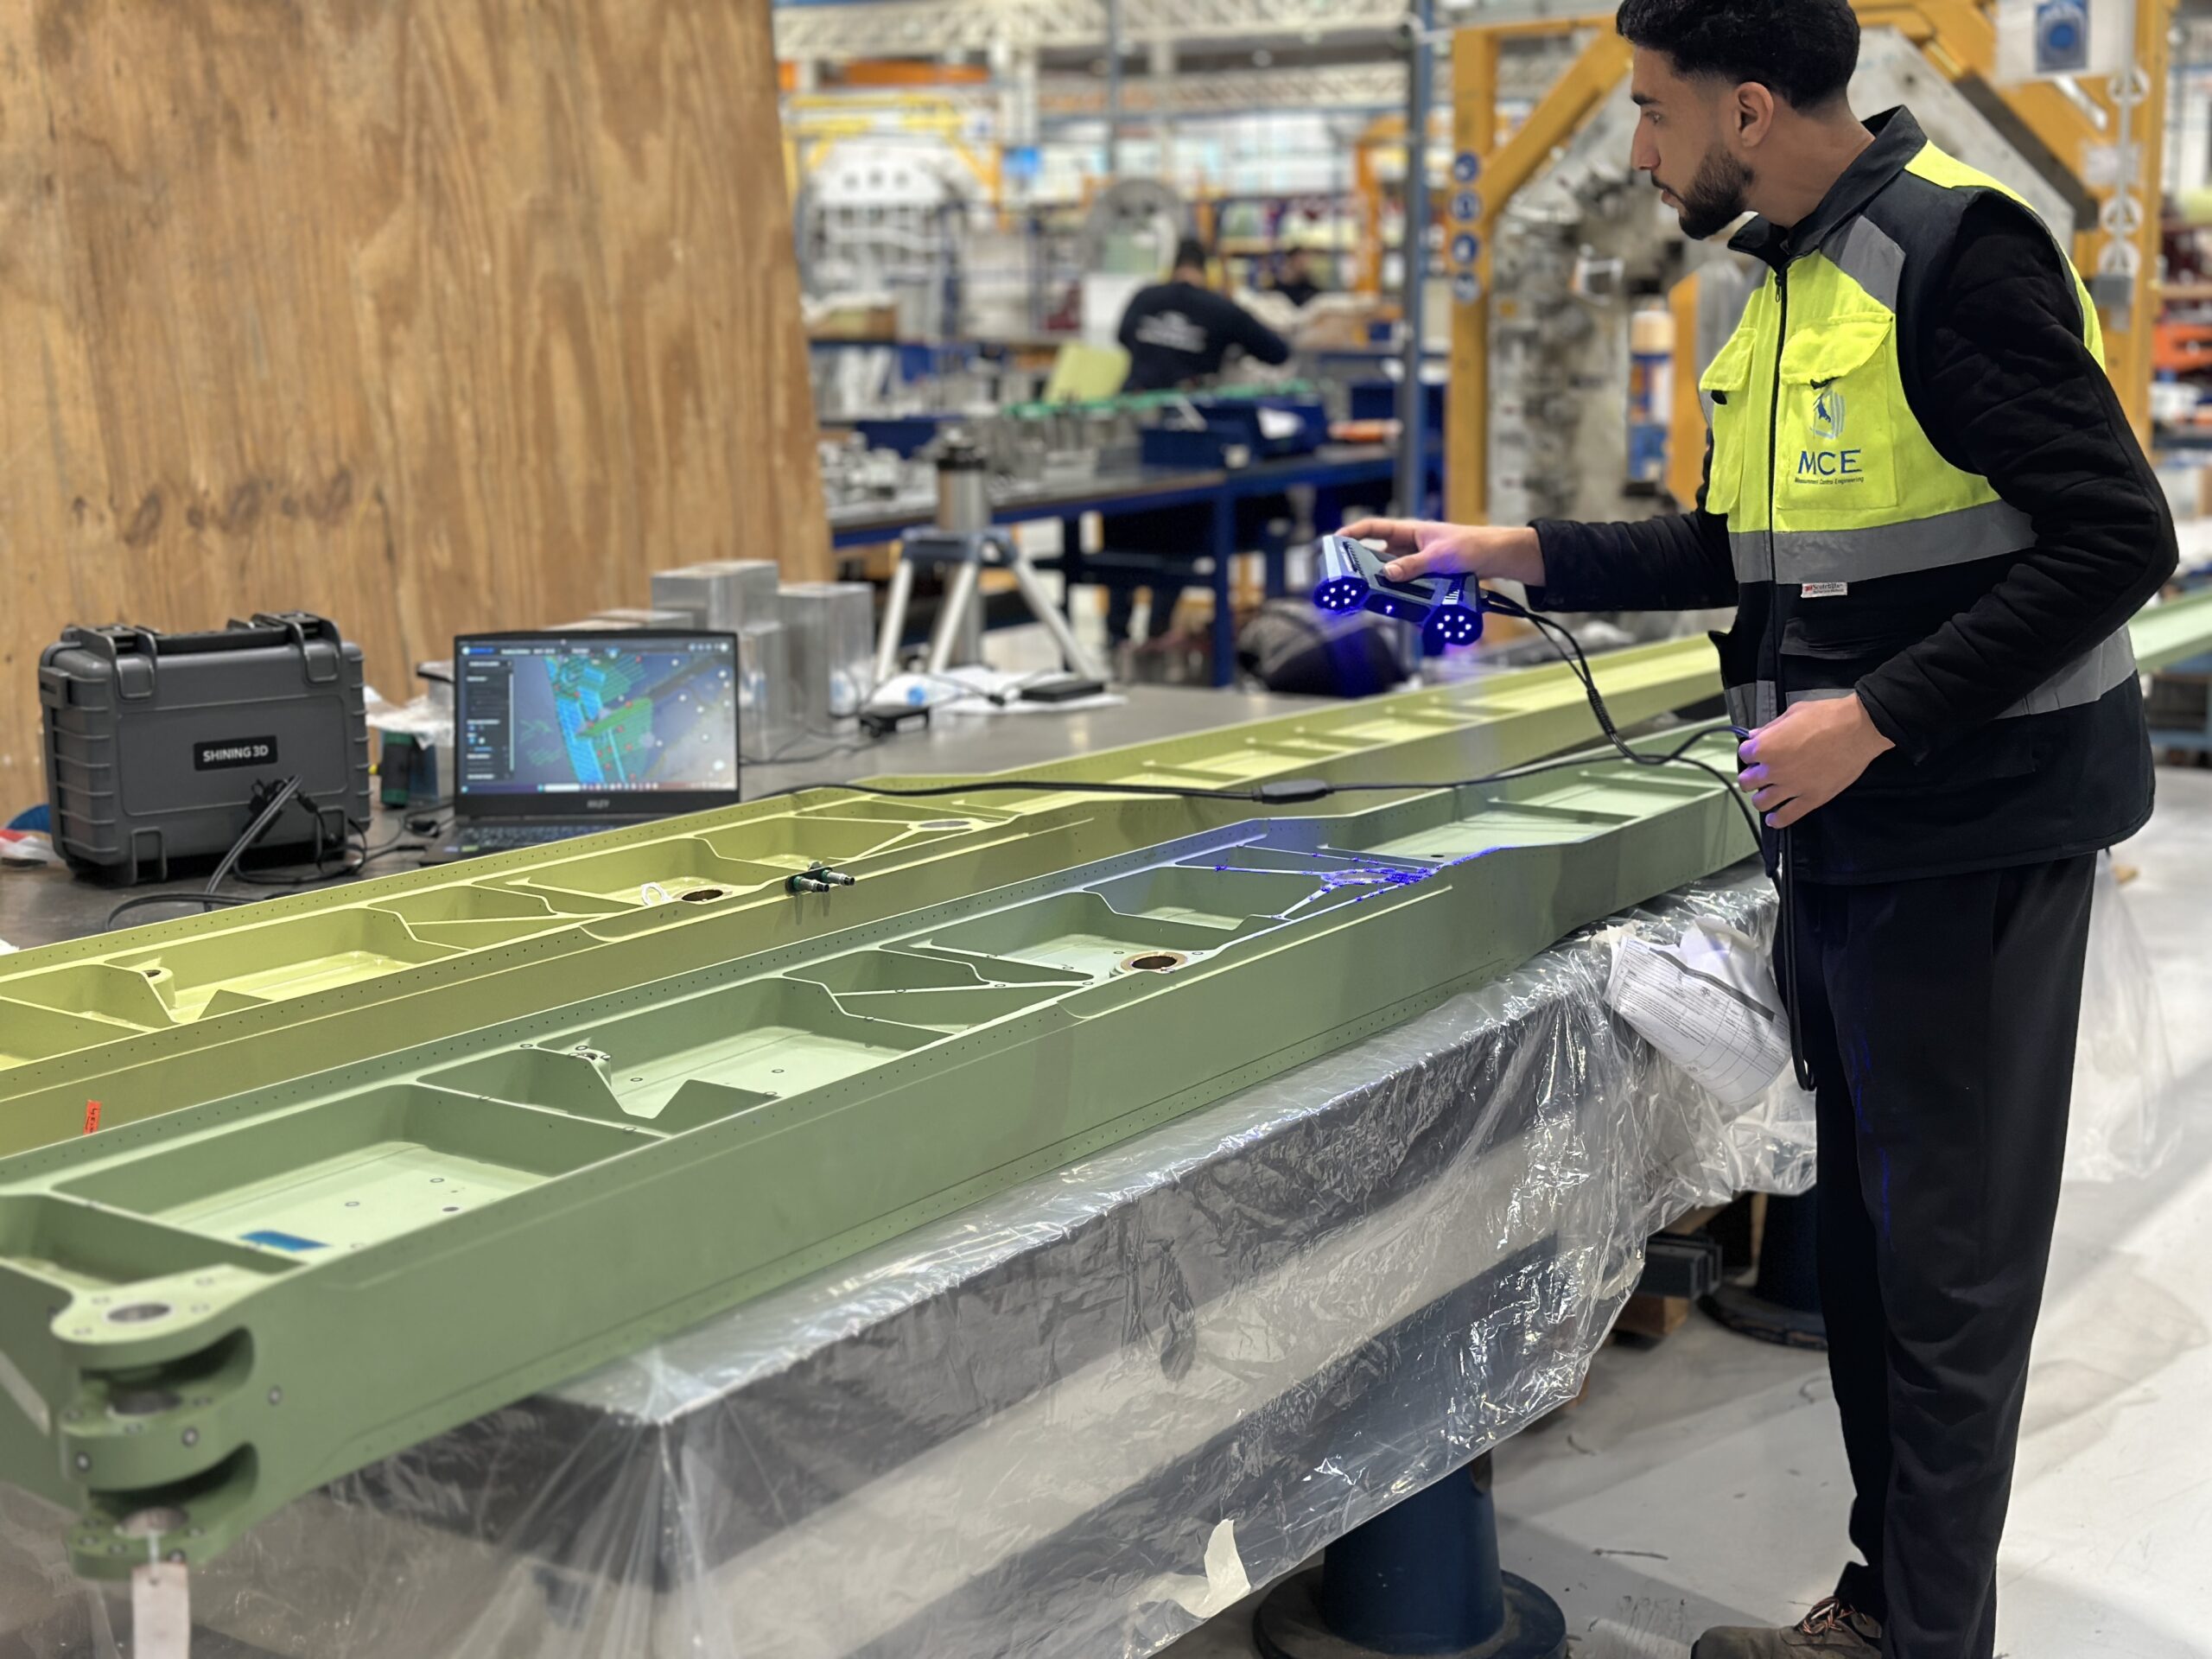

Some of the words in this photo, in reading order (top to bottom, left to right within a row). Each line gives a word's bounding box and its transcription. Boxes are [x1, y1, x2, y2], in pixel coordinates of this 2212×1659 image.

[1797, 448, 1862, 475] MCE
[202, 747, 251, 762] SHINING
[252, 745, 269, 757] 3D
